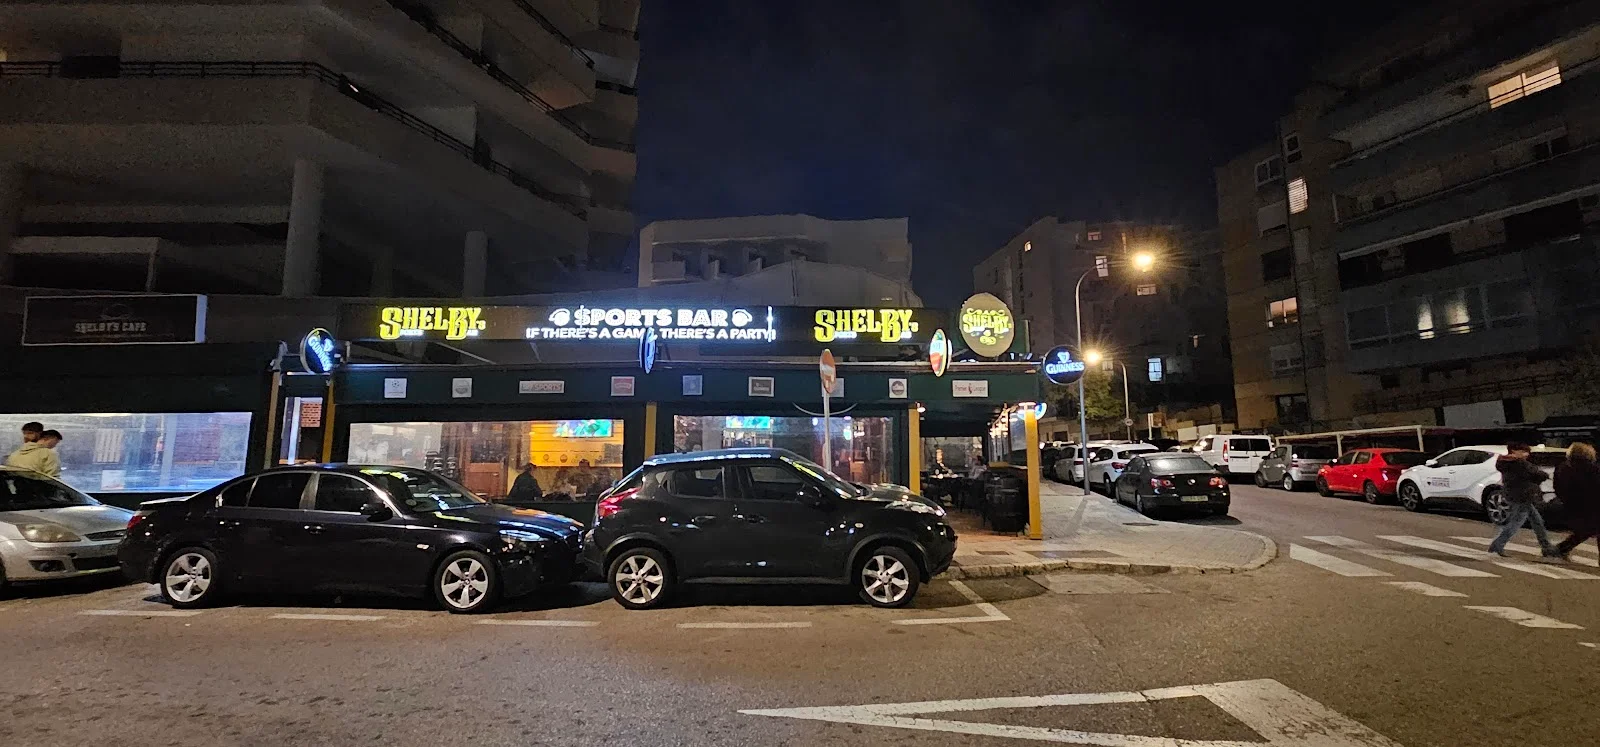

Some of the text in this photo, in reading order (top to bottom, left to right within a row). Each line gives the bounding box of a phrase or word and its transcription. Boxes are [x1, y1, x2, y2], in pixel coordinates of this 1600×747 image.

[379, 307, 486, 340] SHELBY'S
[574, 308, 728, 326] SPORTS BAR
[814, 309, 918, 342] SHELBY'S
[526, 327, 540, 339] IF
[541, 327, 598, 339] THERE'S
[598, 327, 611, 338] A
[659, 328, 715, 339] THERE'S
[716, 328, 728, 339] A
[1046, 361, 1085, 374] GUINNESS
